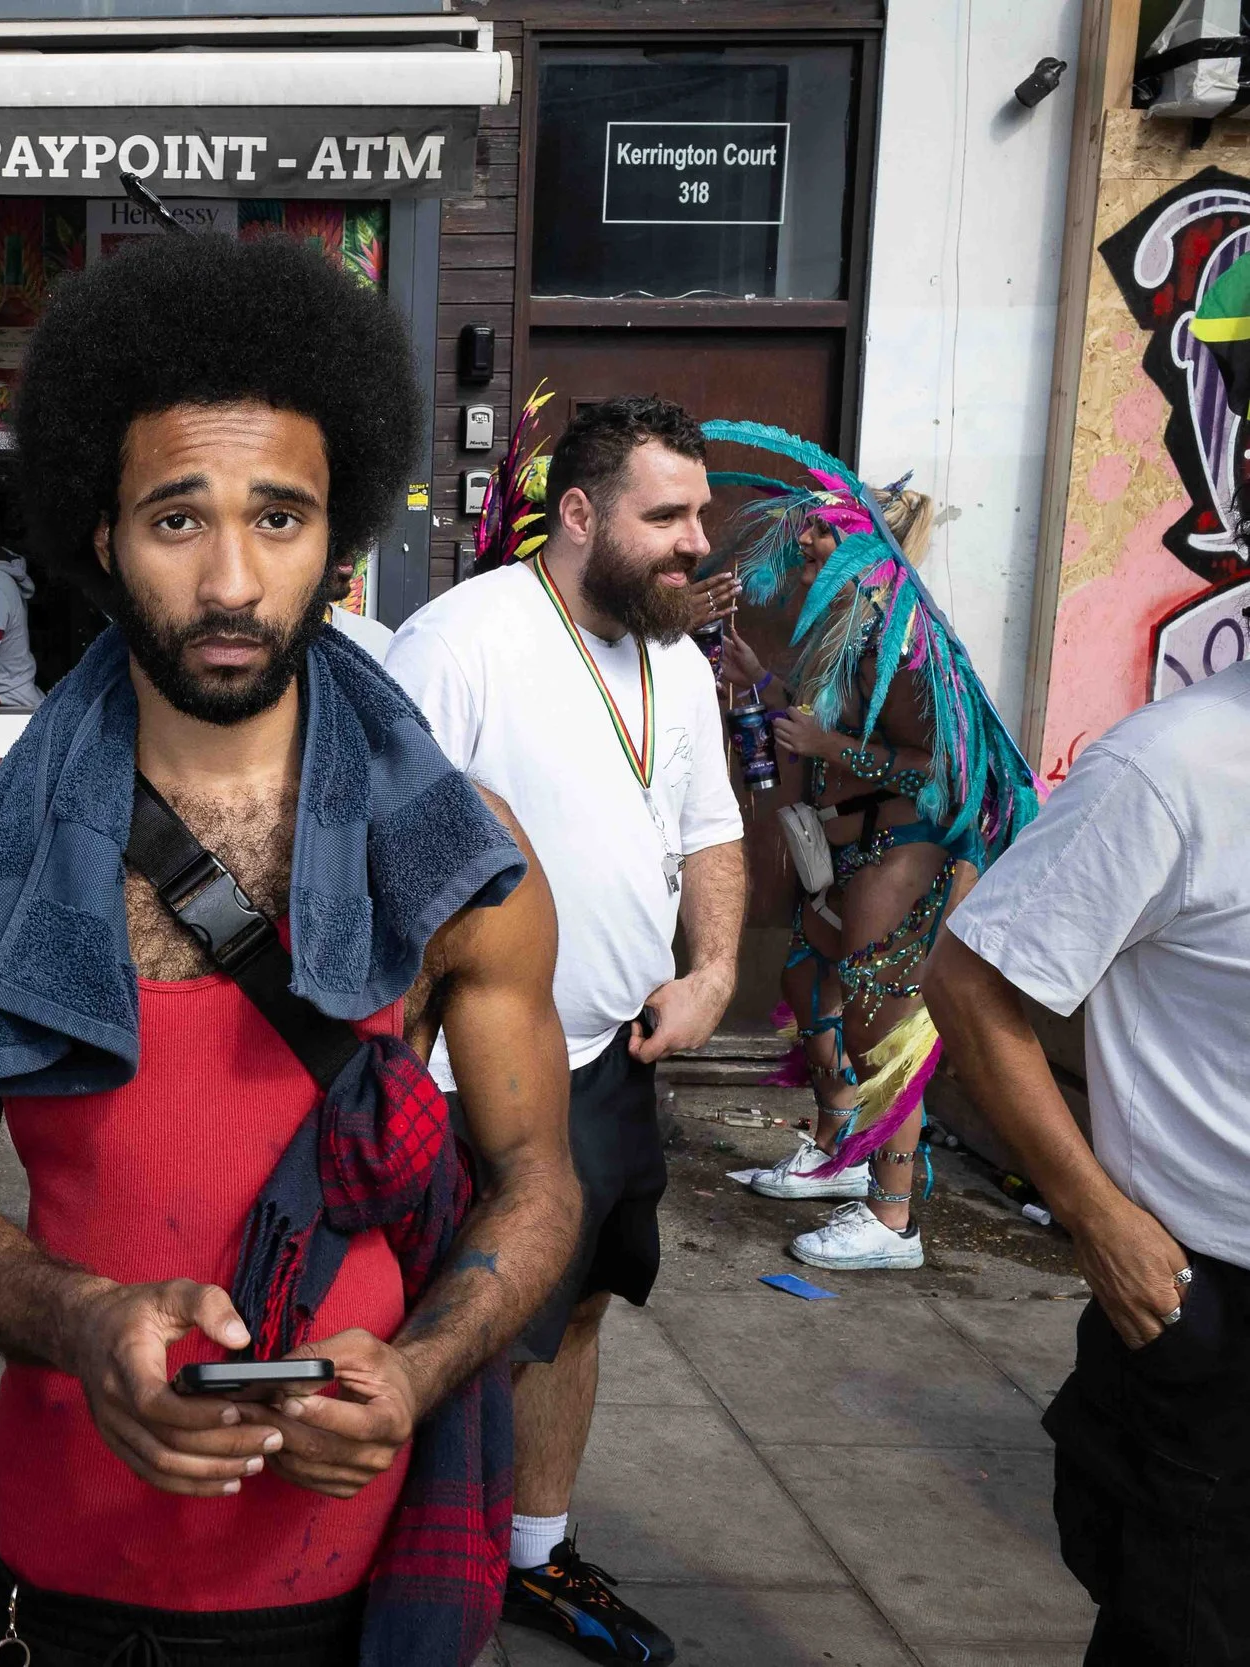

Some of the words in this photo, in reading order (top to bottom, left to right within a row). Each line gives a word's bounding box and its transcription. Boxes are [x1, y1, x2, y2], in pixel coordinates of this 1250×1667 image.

[307, 136, 445, 180] ATM
[616, 142, 717, 171] Kerrington
[723, 143, 777, 166] Court
[678, 181, 710, 204] 318
[112, 202, 219, 228] Henessy
